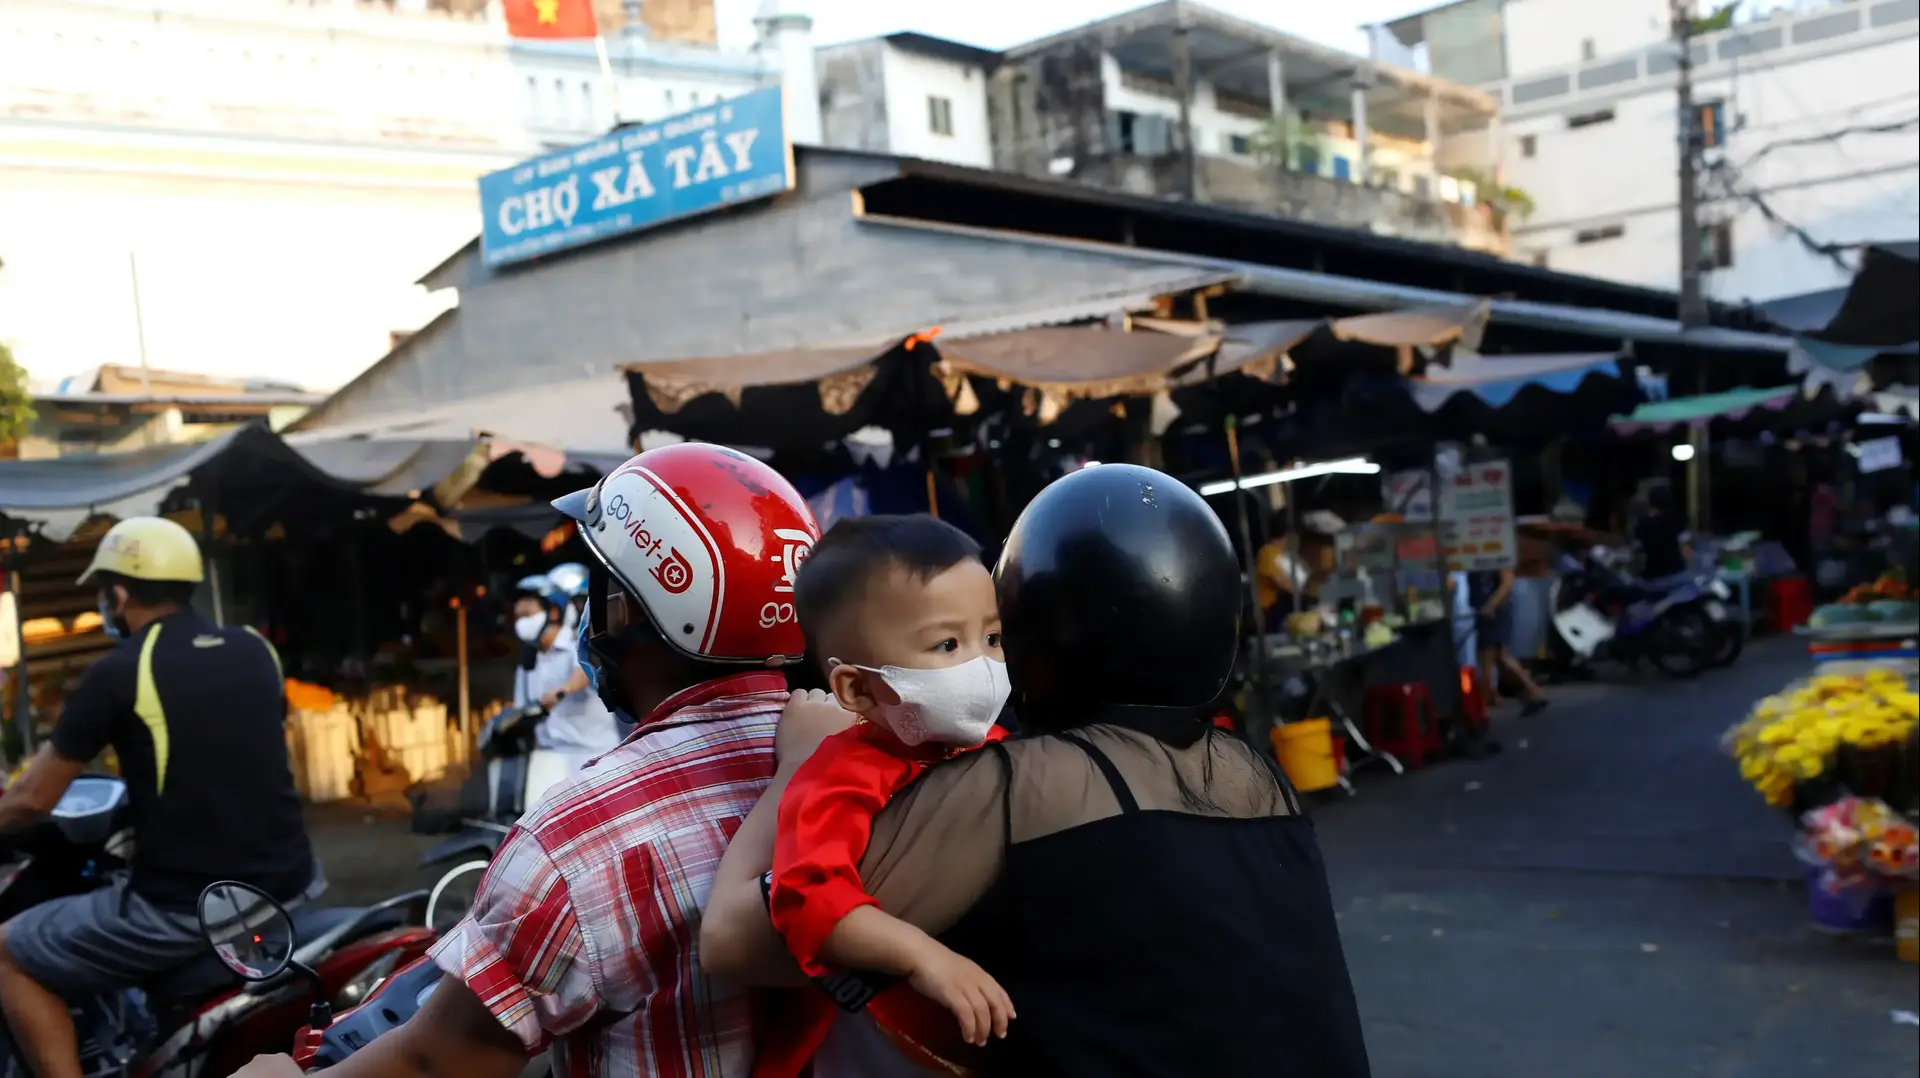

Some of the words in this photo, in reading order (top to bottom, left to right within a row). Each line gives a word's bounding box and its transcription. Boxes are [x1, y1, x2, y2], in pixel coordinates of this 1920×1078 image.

[499, 173, 579, 237] CHỢ
[591, 151, 656, 211] XÃ
[665, 128, 759, 188] TÂY
